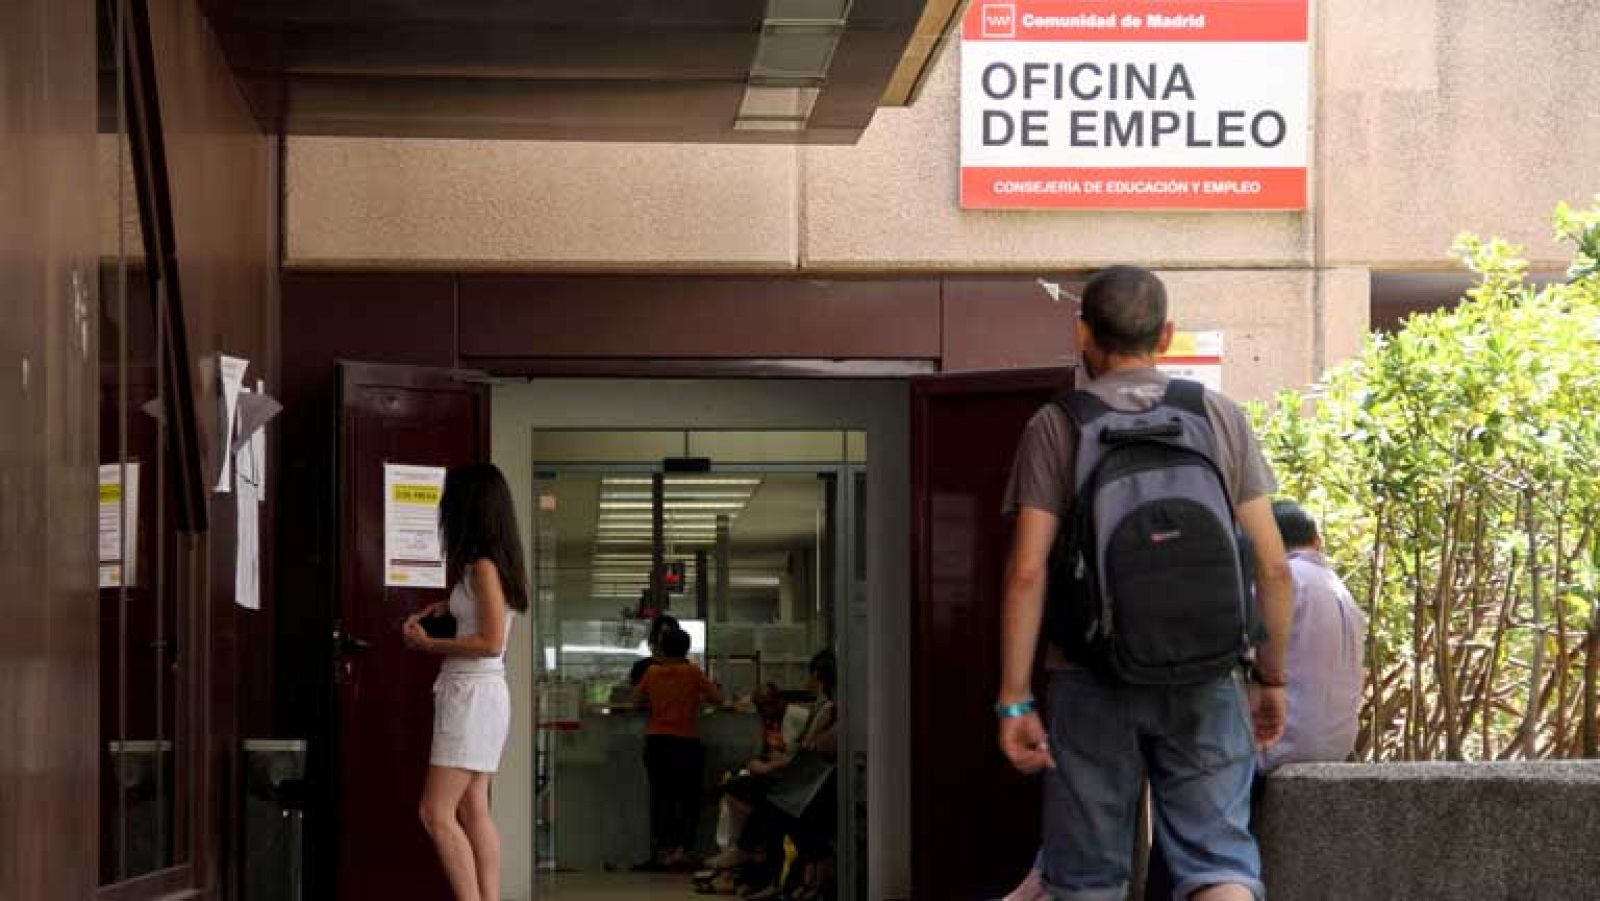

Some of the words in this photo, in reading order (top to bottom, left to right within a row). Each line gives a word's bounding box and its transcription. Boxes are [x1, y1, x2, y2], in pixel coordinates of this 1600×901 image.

[1022, 13, 1117, 28] Comunidad
[1121, 13, 1142, 28] de
[1146, 13, 1205, 28] Madrid
[981, 62, 1196, 101] OFICINA
[982, 109, 1049, 148] DE
[1070, 109, 1287, 148] EMPLEO
[993, 179, 1081, 193] CONSEJERÍA
[1084, 181, 1102, 193] DE
[1106, 179, 1188, 193] EDUCACIÓN
[1191, 181, 1201, 193] Y
[1203, 181, 1261, 193] EMPLEO
